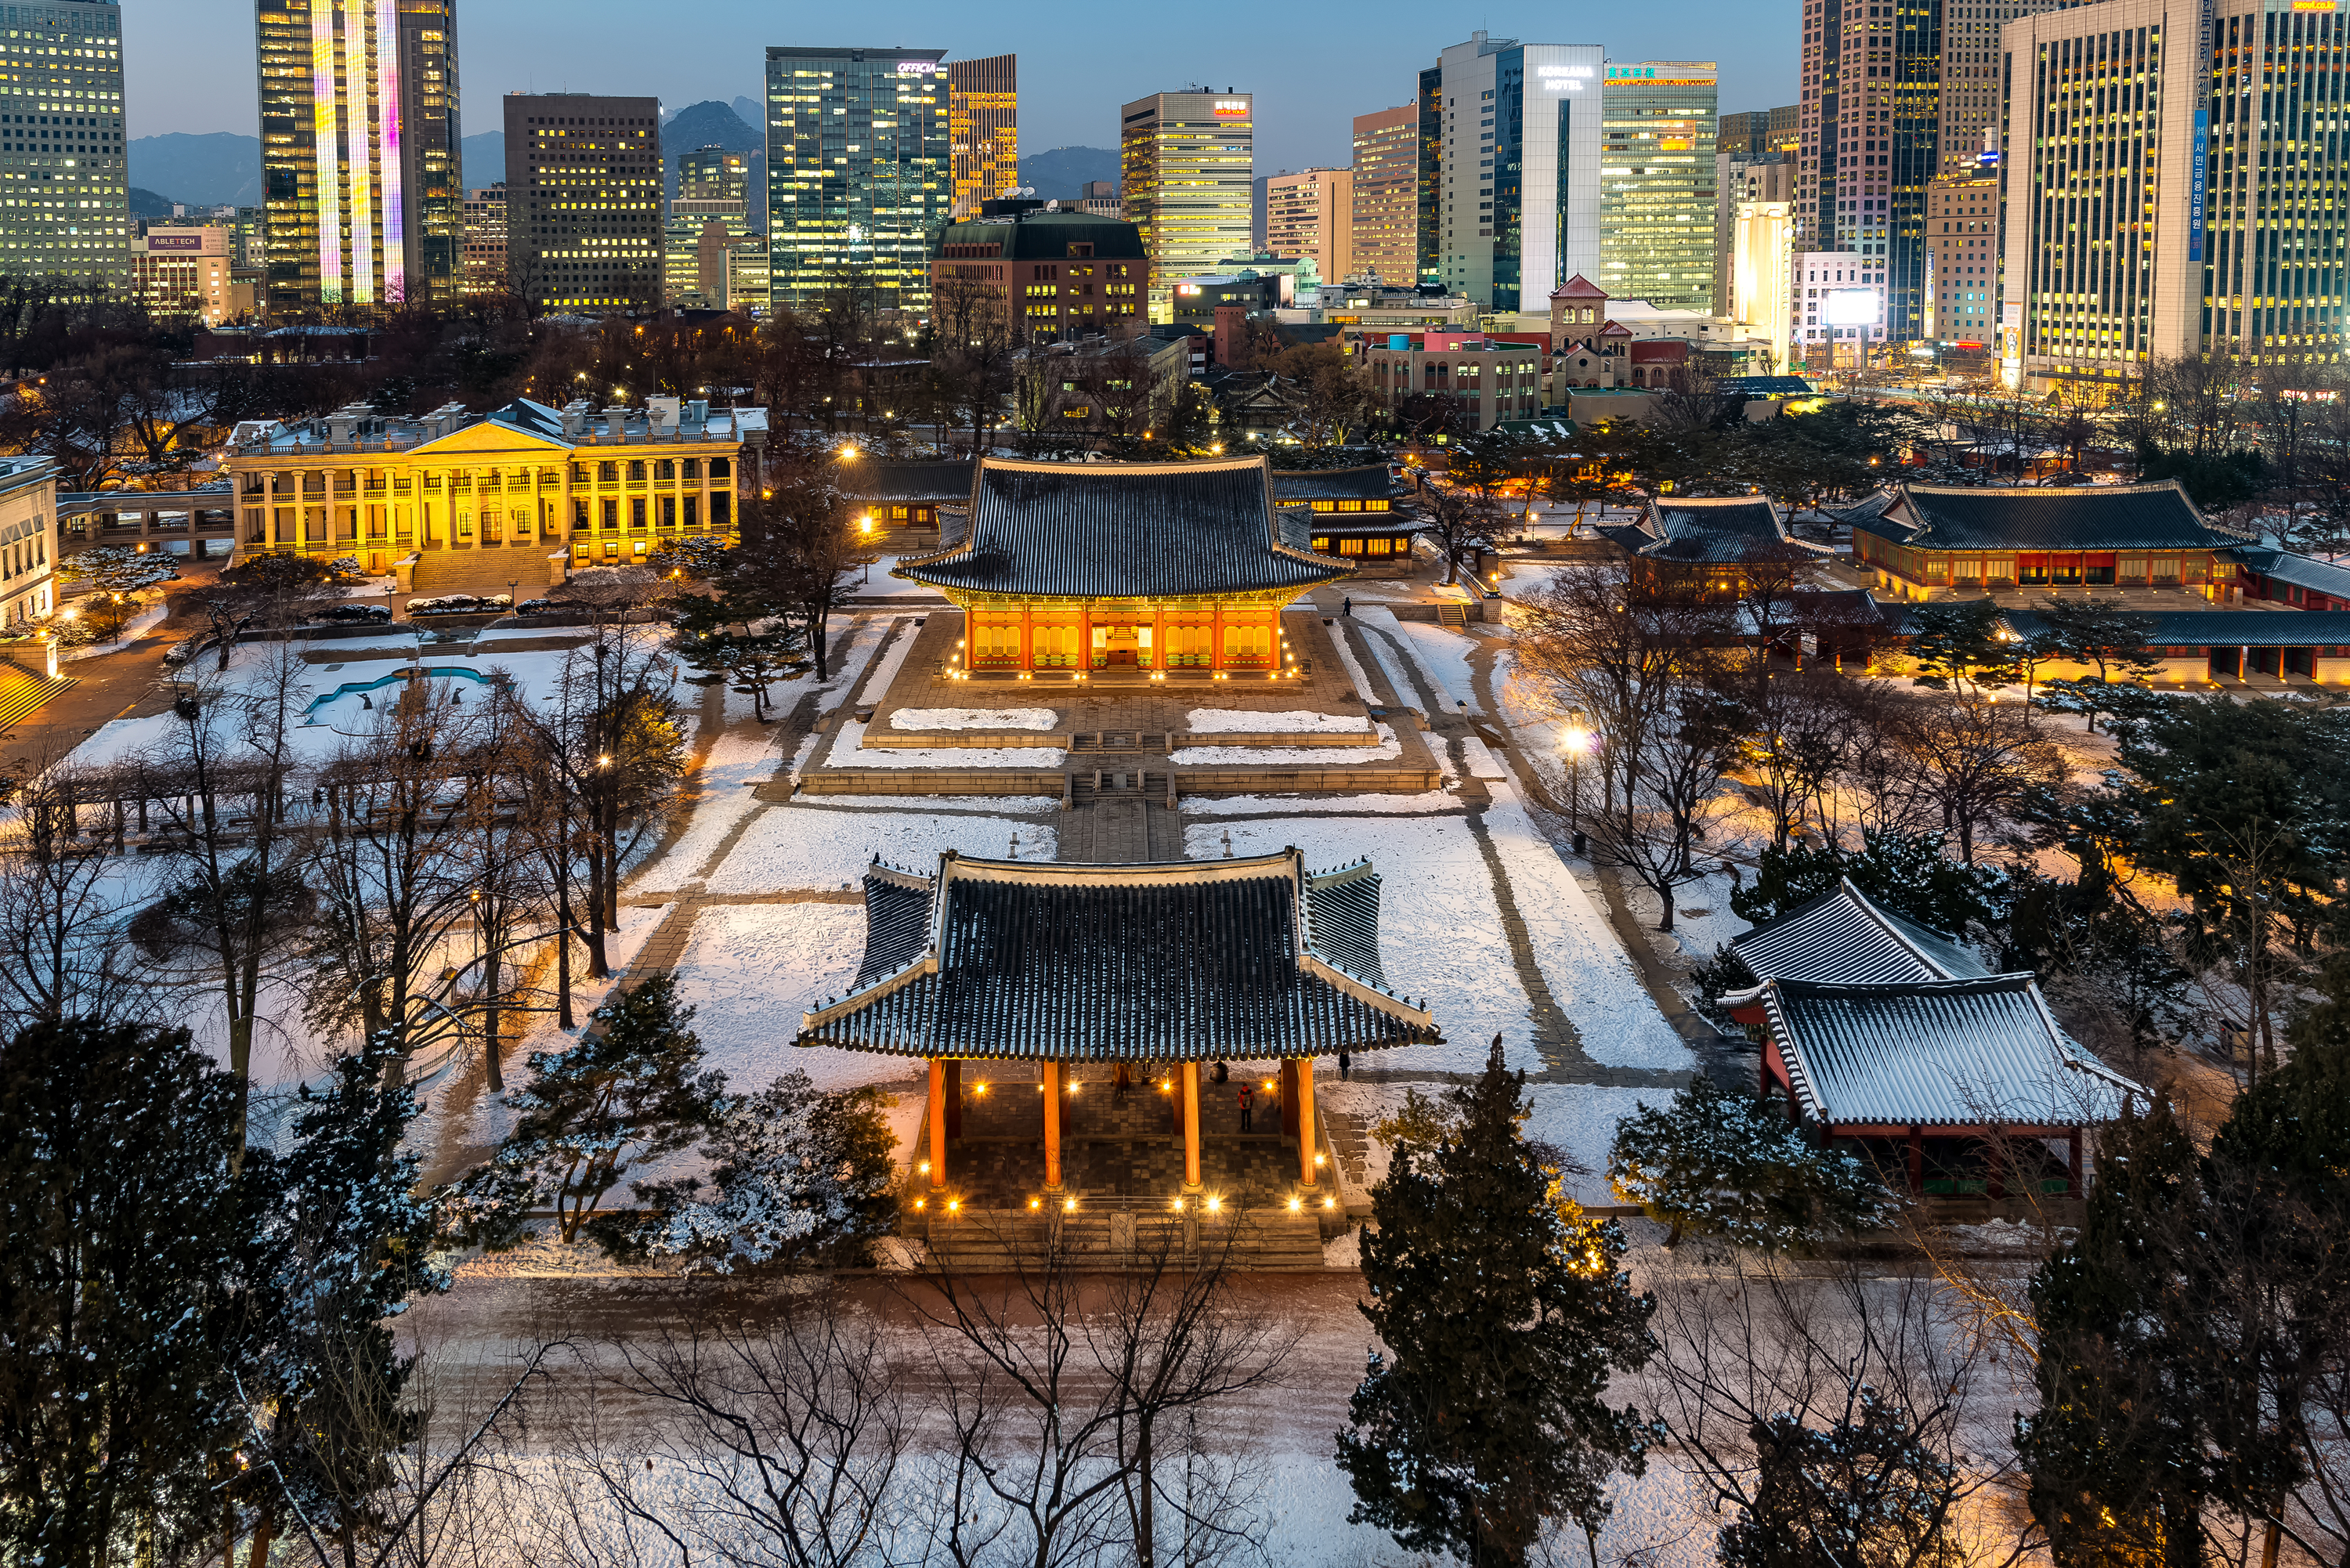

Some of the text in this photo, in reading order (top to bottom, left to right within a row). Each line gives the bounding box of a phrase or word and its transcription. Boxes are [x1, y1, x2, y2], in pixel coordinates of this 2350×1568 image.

[2294, 0, 2335, 9] seoul.co.kr
[898, 63, 936, 73] OFFICIA
[1538, 66, 1593, 78] KOREANA
[1545, 79, 1584, 90] HOTEL
[2193, 143, 2204, 229] 서민금융진흥원
